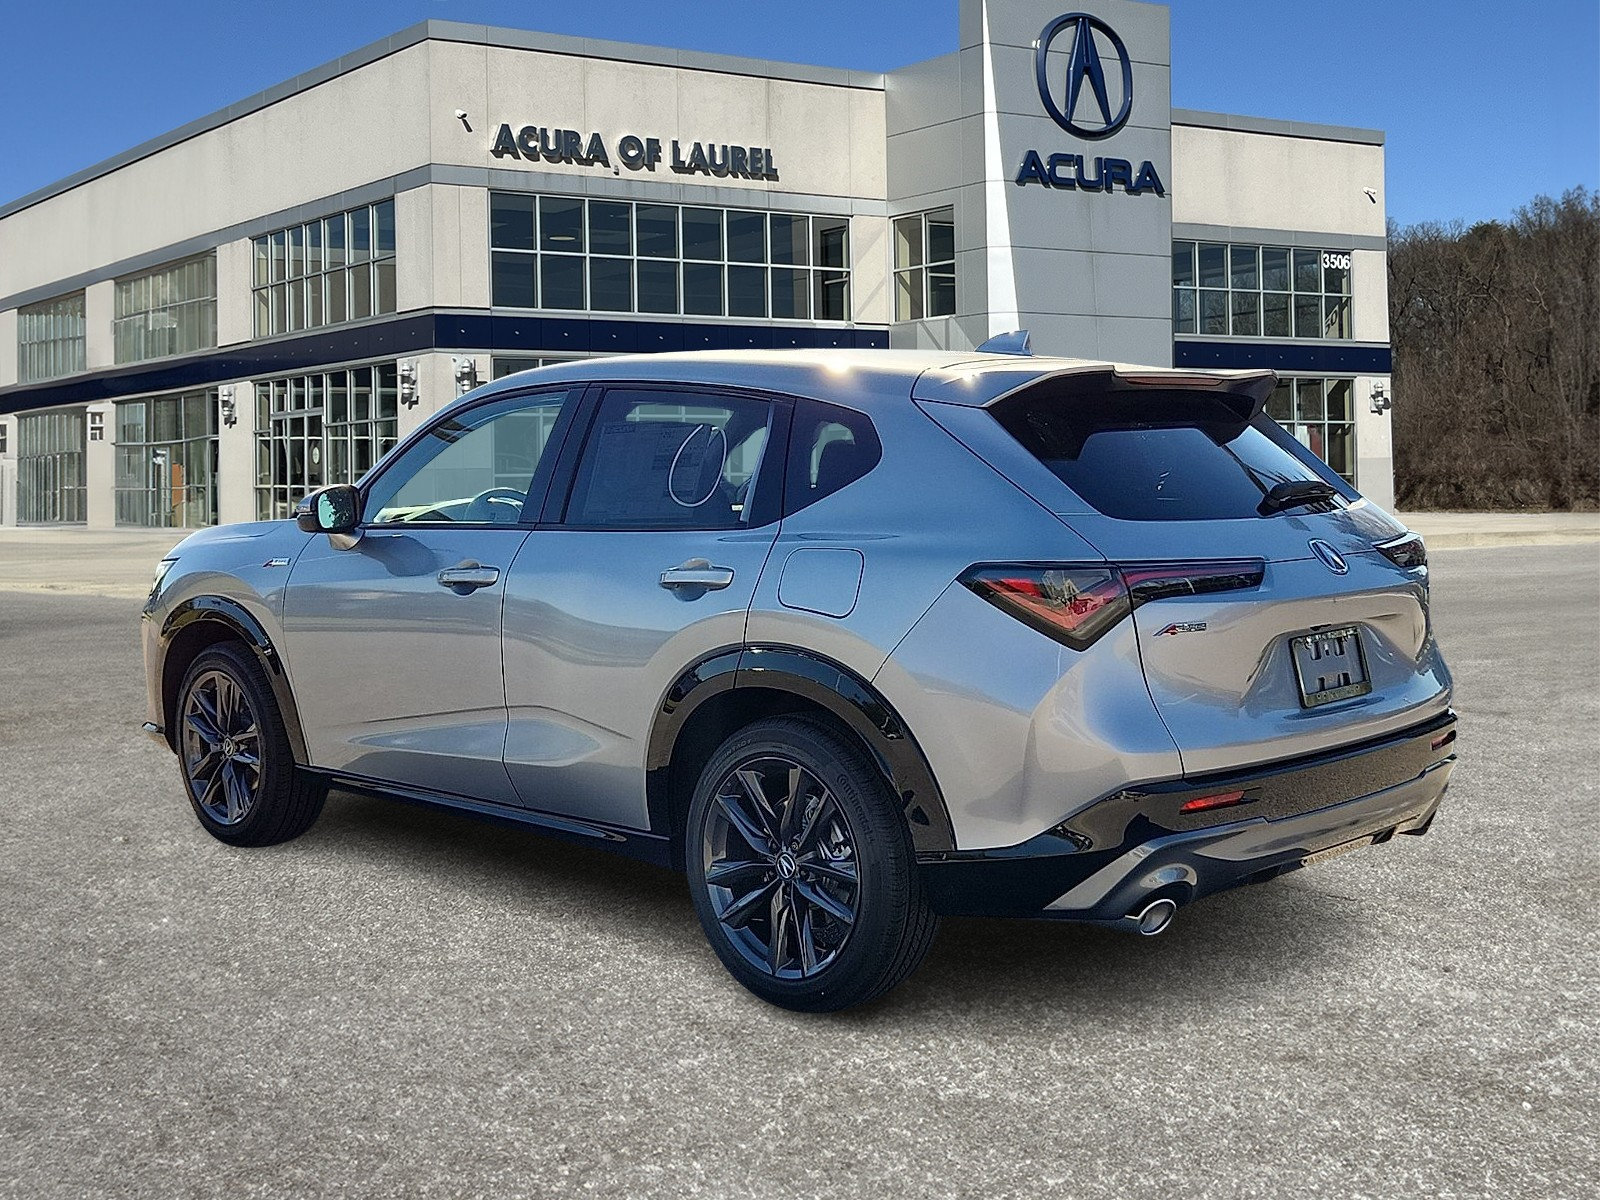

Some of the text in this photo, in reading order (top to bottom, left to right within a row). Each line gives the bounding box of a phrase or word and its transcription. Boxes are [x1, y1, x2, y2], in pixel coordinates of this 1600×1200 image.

[491, 123, 779, 182] ACURA OF LAUREL
[1016, 150, 1165, 198] ACURA
[1322, 253, 1351, 270] 3506
